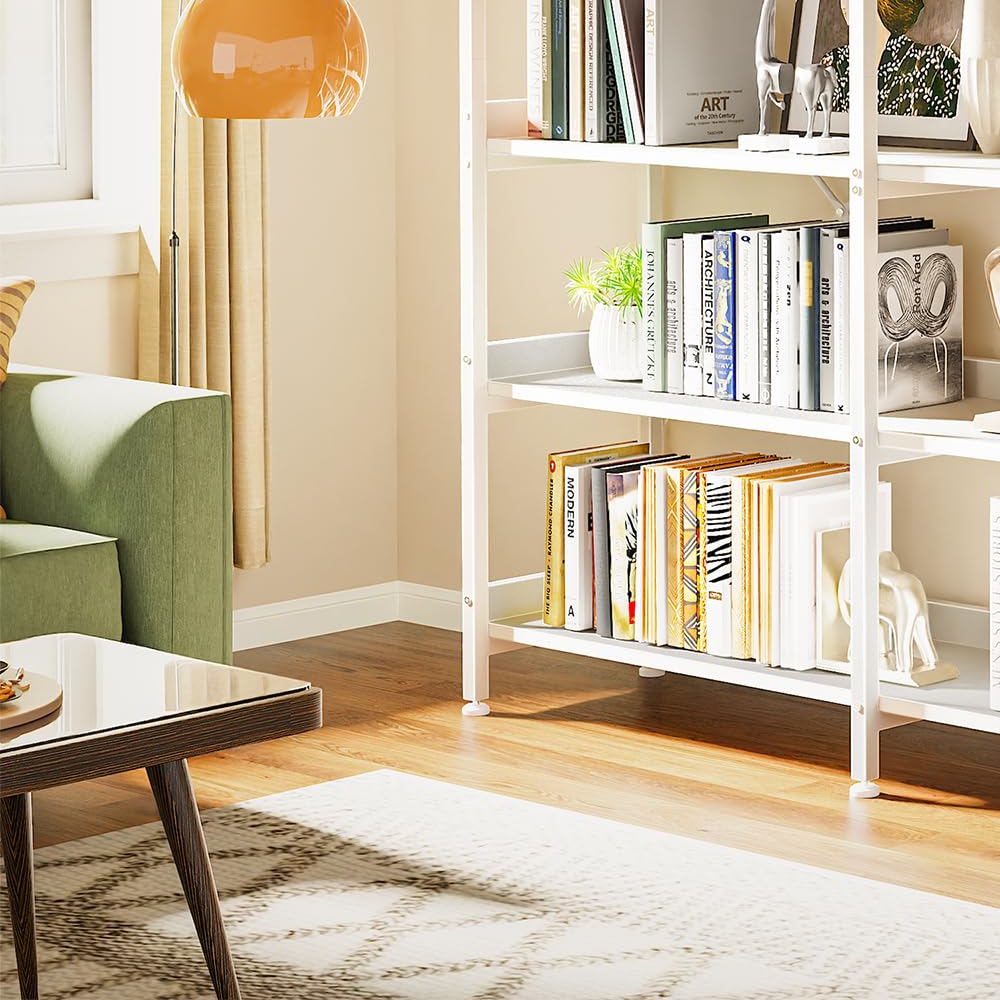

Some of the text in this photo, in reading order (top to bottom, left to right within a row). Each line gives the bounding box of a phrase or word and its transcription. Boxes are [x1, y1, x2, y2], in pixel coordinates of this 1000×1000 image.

[646, 8, 655, 36] ART
[530, 47, 541, 114] WINES
[701, 96, 729, 112] ART
[719, 112, 736, 120] Century
[646, 249, 656, 317] JOHANNES
[666, 280, 678, 296] arts
[704, 250, 714, 354] ARCHITECTURE
[821, 277, 831, 296] arts
[912, 254, 921, 313] Ron Arad
[666, 308, 679, 353] architecture
[821, 310, 833, 365] architecture
[567, 477, 575, 539] MODERN
[568, 605, 575, 617] A
